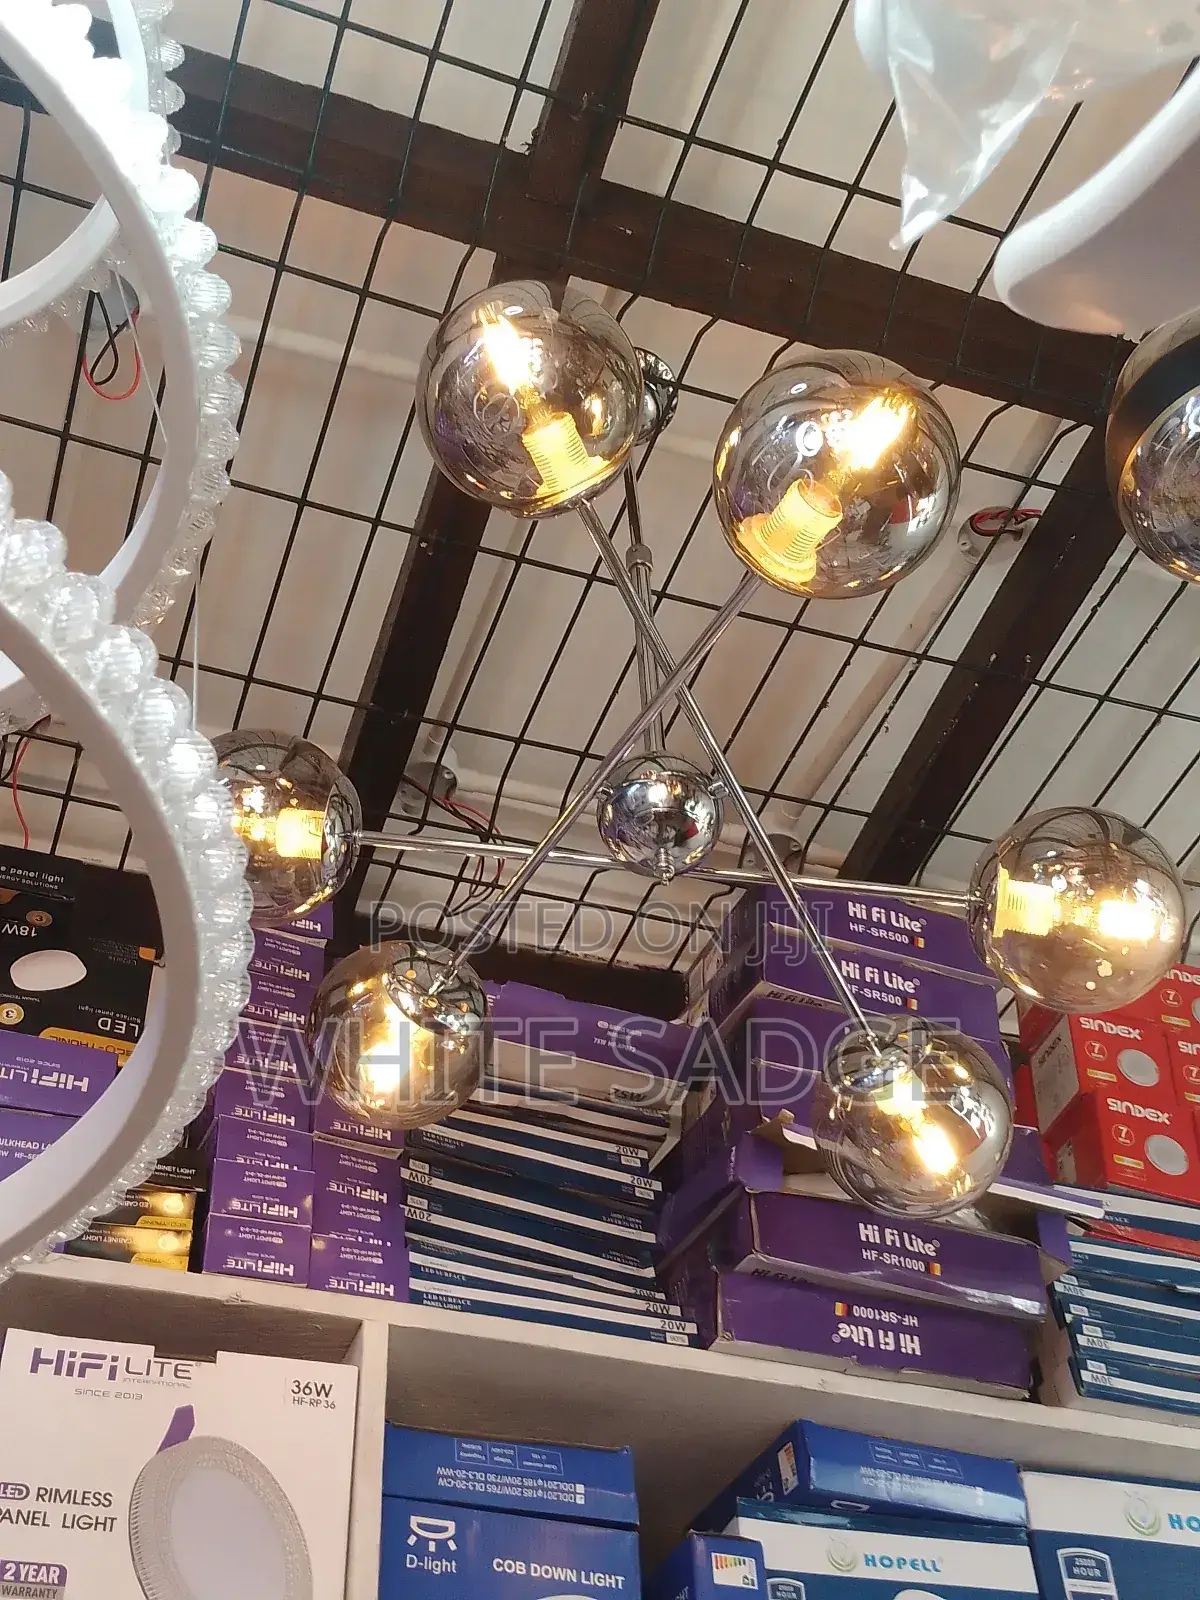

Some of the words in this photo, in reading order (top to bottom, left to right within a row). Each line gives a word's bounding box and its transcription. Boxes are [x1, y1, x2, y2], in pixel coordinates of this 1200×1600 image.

[10, 868, 39, 879] panel
[42, 872, 65, 884] light
[21, 878, 59, 890] SOLUTIONS
[848, 901, 867, 920] Hi
[871, 906, 887, 924] Fi
[890, 910, 922, 933] Lite
[1, 923, 38, 937] 18W
[849, 921, 909, 945] HF-SR500
[841, 959, 860, 980] Hi
[864, 966, 880, 985] Fi
[883, 970, 916, 993] Lite
[847, 983, 903, 1006] F-SR500
[1166, 990, 1176, 1000] 7
[97, 1017, 140, 1038] LED
[1079, 1016, 1143, 1041] SINDEX
[1091, 1041, 1100, 1054] 7
[1106, 1097, 1171, 1125] SINDEX
[1118, 1126, 1128, 1138] 7
[615, 1145, 640, 1157] 20W
[408, 1170, 434, 1186] 20W
[630, 1175, 654, 1189] 20W
[406, 1207, 432, 1222] 20W
[858, 1222, 881, 1245] Hi
[884, 1227, 901, 1248] Fi
[902, 1231, 938, 1257] Lite
[861, 1248, 926, 1273] HF-SR1000
[423, 1292, 438, 1300] LED
[438, 1294, 472, 1307] SURFACE
[645, 1302, 671, 1315] 20W
[660, 1320, 687, 1332] 20W
[852, 1304, 919, 1328] HF-SR1000
[837, 1322, 875, 1348] Lite
[878, 1328, 896, 1351] Fi
[898, 1332, 922, 1356] Hi
[114, 1391, 144, 1401] 2013
[291, 1379, 333, 1398] 36W
[0, 1483, 28, 1499] LED
[35, 1486, 114, 1508] RIMLESS
[61, 1512, 118, 1533] LIGHT
[3, 1562, 17, 1581] 2
[19, 1563, 60, 1584] YEAR
[406, 1553, 458, 1575] D-light
[864, 1553, 942, 1573] HOPELL
[1072, 1566, 1102, 1578] HOUR
[493, 1557, 526, 1575] COB
[530, 1563, 577, 1583] DOWN
[580, 1571, 626, 1590] LIGHT
[1, 1584, 58, 1600] WARRANTY
